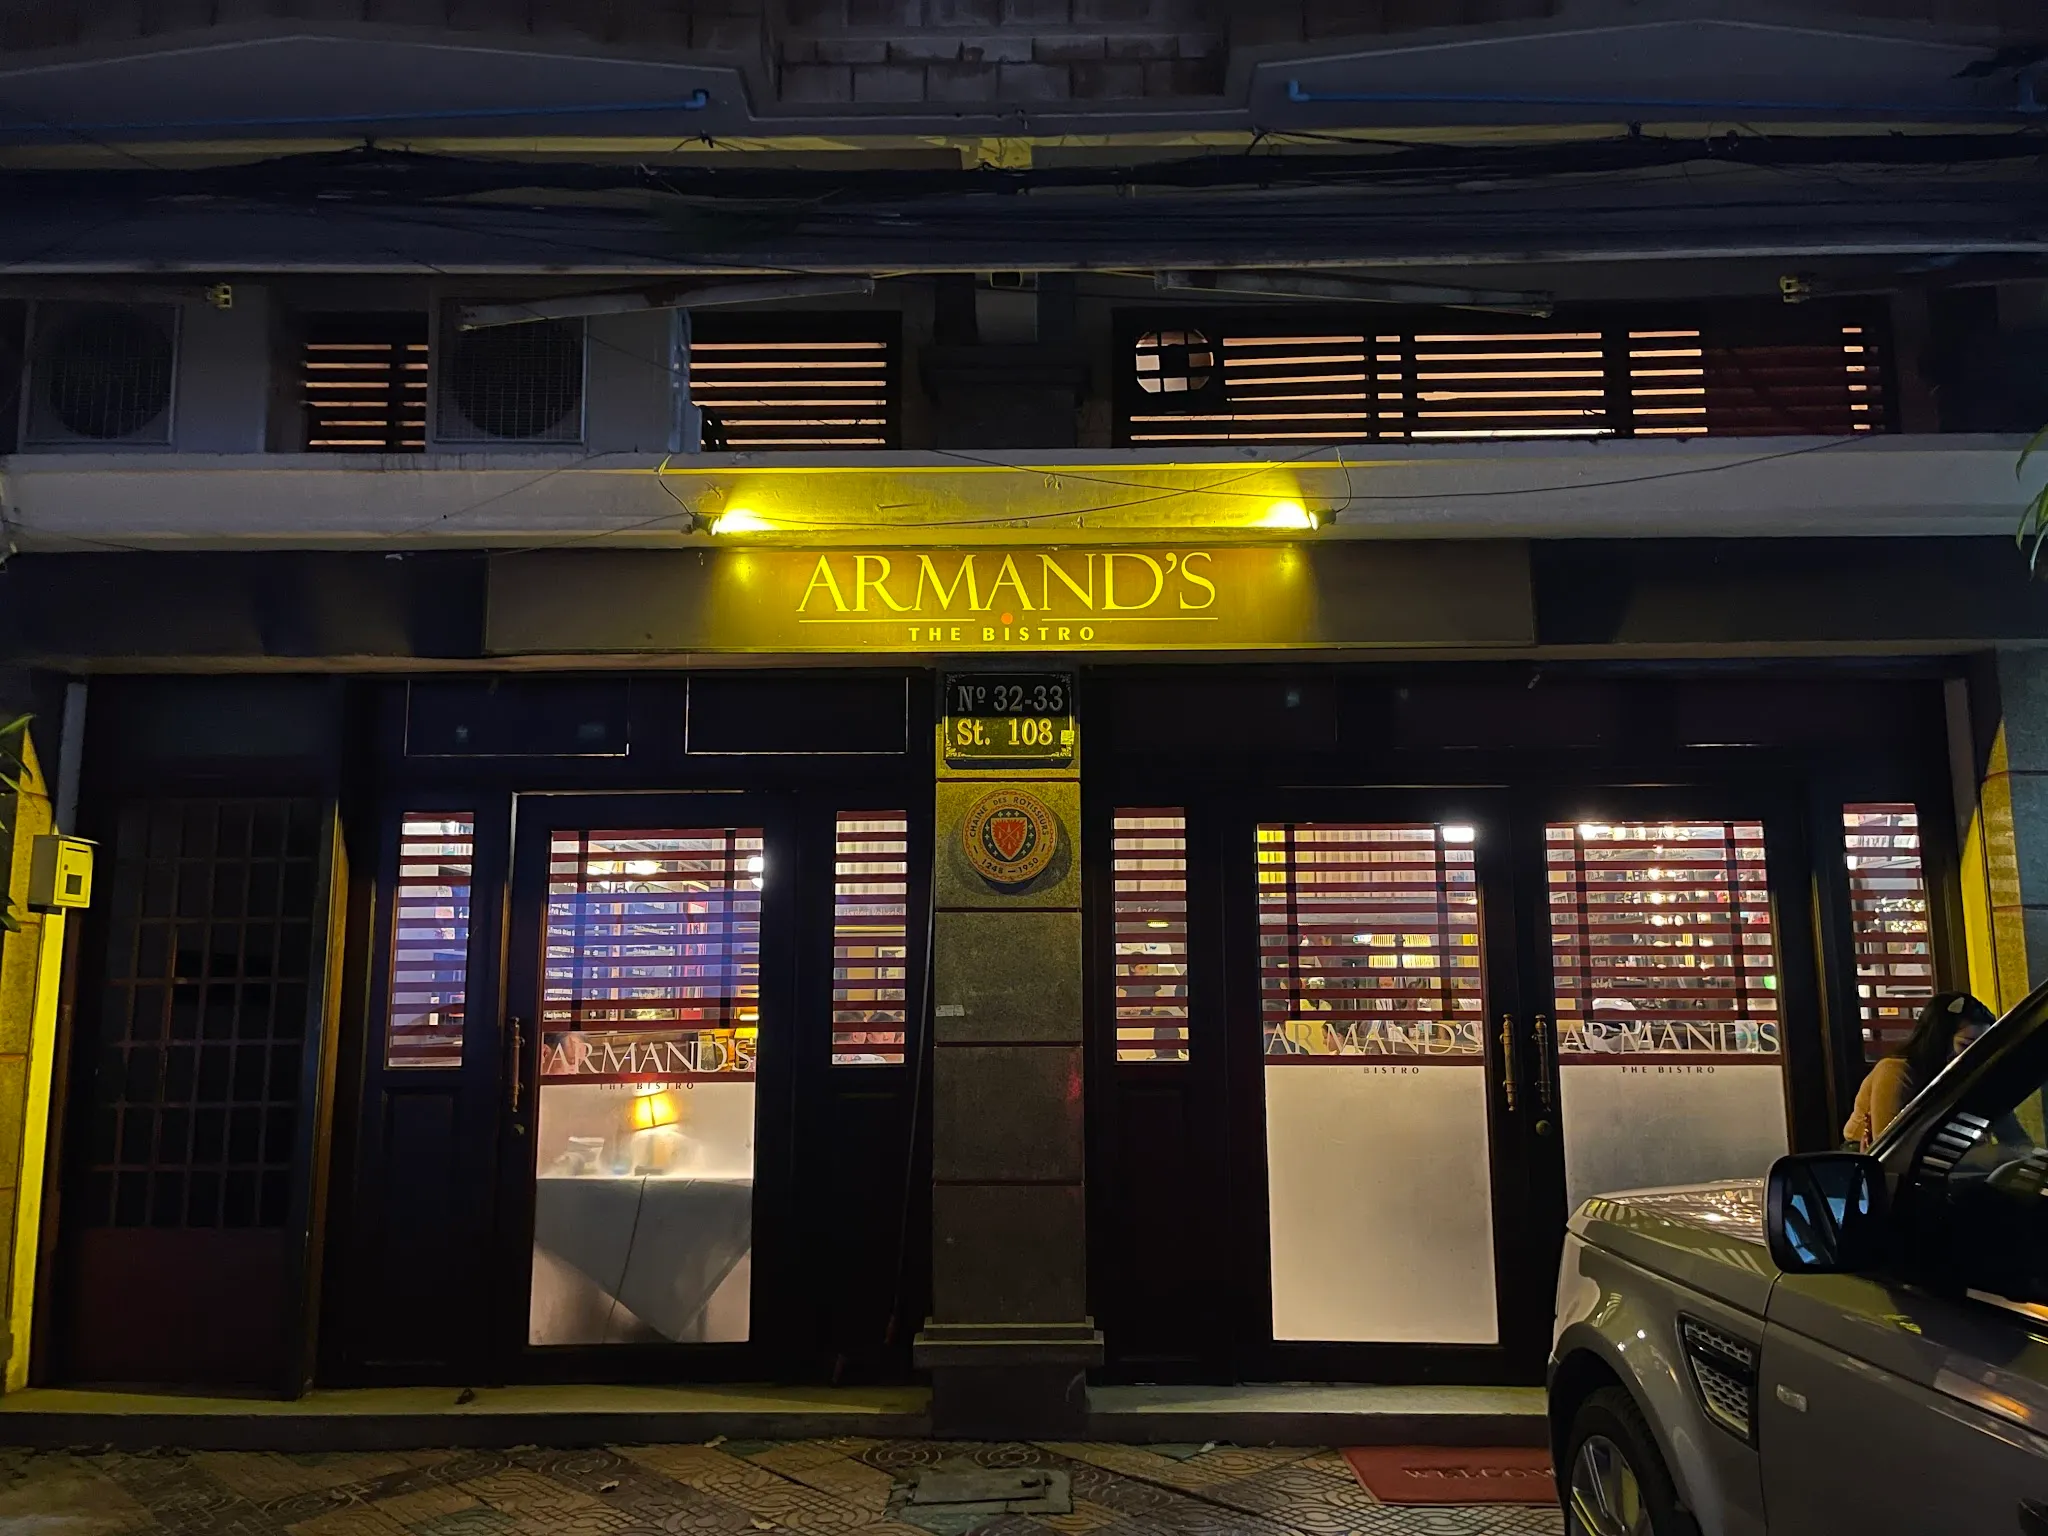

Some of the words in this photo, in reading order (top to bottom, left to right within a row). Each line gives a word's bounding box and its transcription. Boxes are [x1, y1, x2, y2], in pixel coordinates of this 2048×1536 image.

[795, 551, 1216, 612] ARMAND'S
[908, 627, 961, 642] THE
[982, 626, 1095, 642] BISTRO
[993, 685, 1063, 712] 32-33
[957, 718, 991, 745] St.
[1008, 717, 1053, 745] 108
[969, 805, 989, 837] CHAINE
[992, 796, 1007, 806] DES
[1013, 796, 1049, 836] ROTISSEURS
[1265, 1022, 1481, 1055] ARMAND'S
[1363, 1066, 1420, 1075] BISTRO
[1621, 1066, 1648, 1074] THE
[1657, 1066, 1715, 1074] BISTRO
[1401, 1466, 1556, 1479] WELCOM
